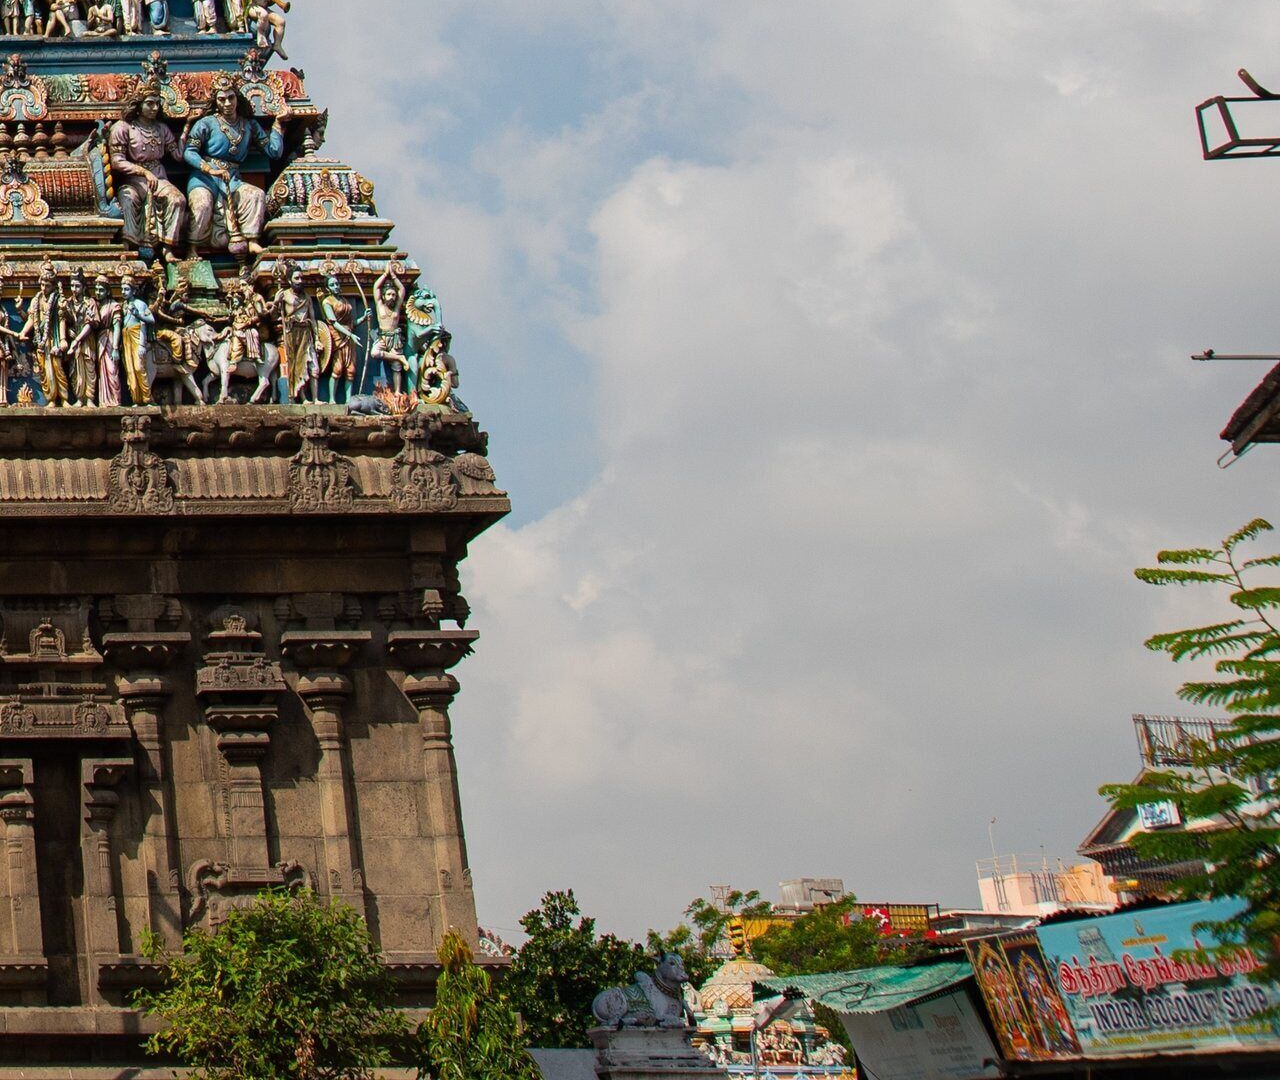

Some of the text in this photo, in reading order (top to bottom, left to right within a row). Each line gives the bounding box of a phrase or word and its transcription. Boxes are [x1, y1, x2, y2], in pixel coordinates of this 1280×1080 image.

[1090, 986, 1268, 1031] INDIRA COCONUT SHOP
